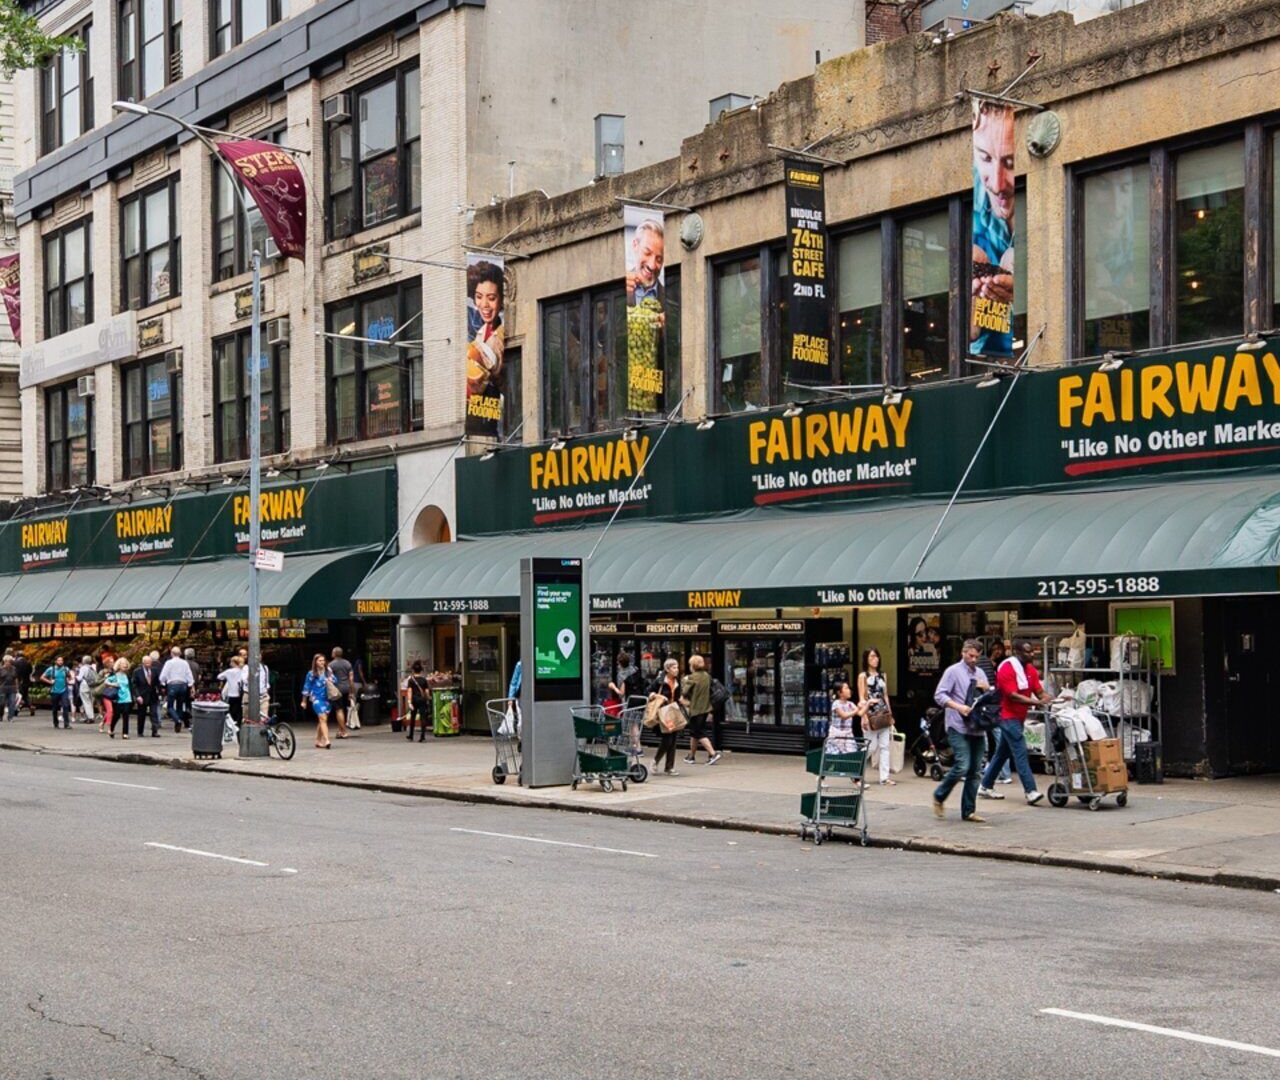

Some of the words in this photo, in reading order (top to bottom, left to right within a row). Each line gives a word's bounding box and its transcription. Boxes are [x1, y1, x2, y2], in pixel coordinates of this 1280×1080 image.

[791, 208, 822, 221] INDULGE
[792, 228, 823, 249] 74TH
[792, 248, 823, 261] STREET
[793, 260, 824, 279] CAFE
[793, 283, 813, 297] 2ND
[815, 284, 825, 298] FL
[800, 335, 825, 350] PLACE
[792, 346, 828, 365] FOODING
[749, 399, 913, 465] FAIRWAY
[1061, 439, 1108, 458] "Like
[1114, 434, 1142, 455] No
[1147, 429, 1207, 450] Other
[530, 435, 650, 490] FAIRWAY
[752, 474, 785, 490] "Like
[789, 471, 808, 487] No
[812, 467, 852, 486] Other
[856, 457, 917, 481] Market"
[234, 487, 305, 525] FARWAY
[532, 497, 557, 511] "Like
[559, 495, 573, 509] No
[575, 492, 606, 507] Other
[608, 483, 653, 504] Market"
[117, 505, 172, 538] FAIRWAY
[22, 519, 67, 548] FAIRWAY
[817, 590, 846, 604] "Like
[848, 588, 864, 602] No
[867, 587, 901, 601] Other
[904, 585, 952, 600] Market"
[1037, 576, 1160, 597] 212-595-1888
[357, 600, 391, 613] FAIRWAY
[433, 600, 489, 611] 212-595-1888
[592, 597, 624, 609] Market"
[688, 590, 741, 608] FAIRWAY
[646, 624, 665, 633] FRESH
[666, 624, 680, 632] CUT
[681, 624, 699, 632] FRUIT
[721, 623, 736, 631] FRESH
[737, 623, 751, 631] JUICE
